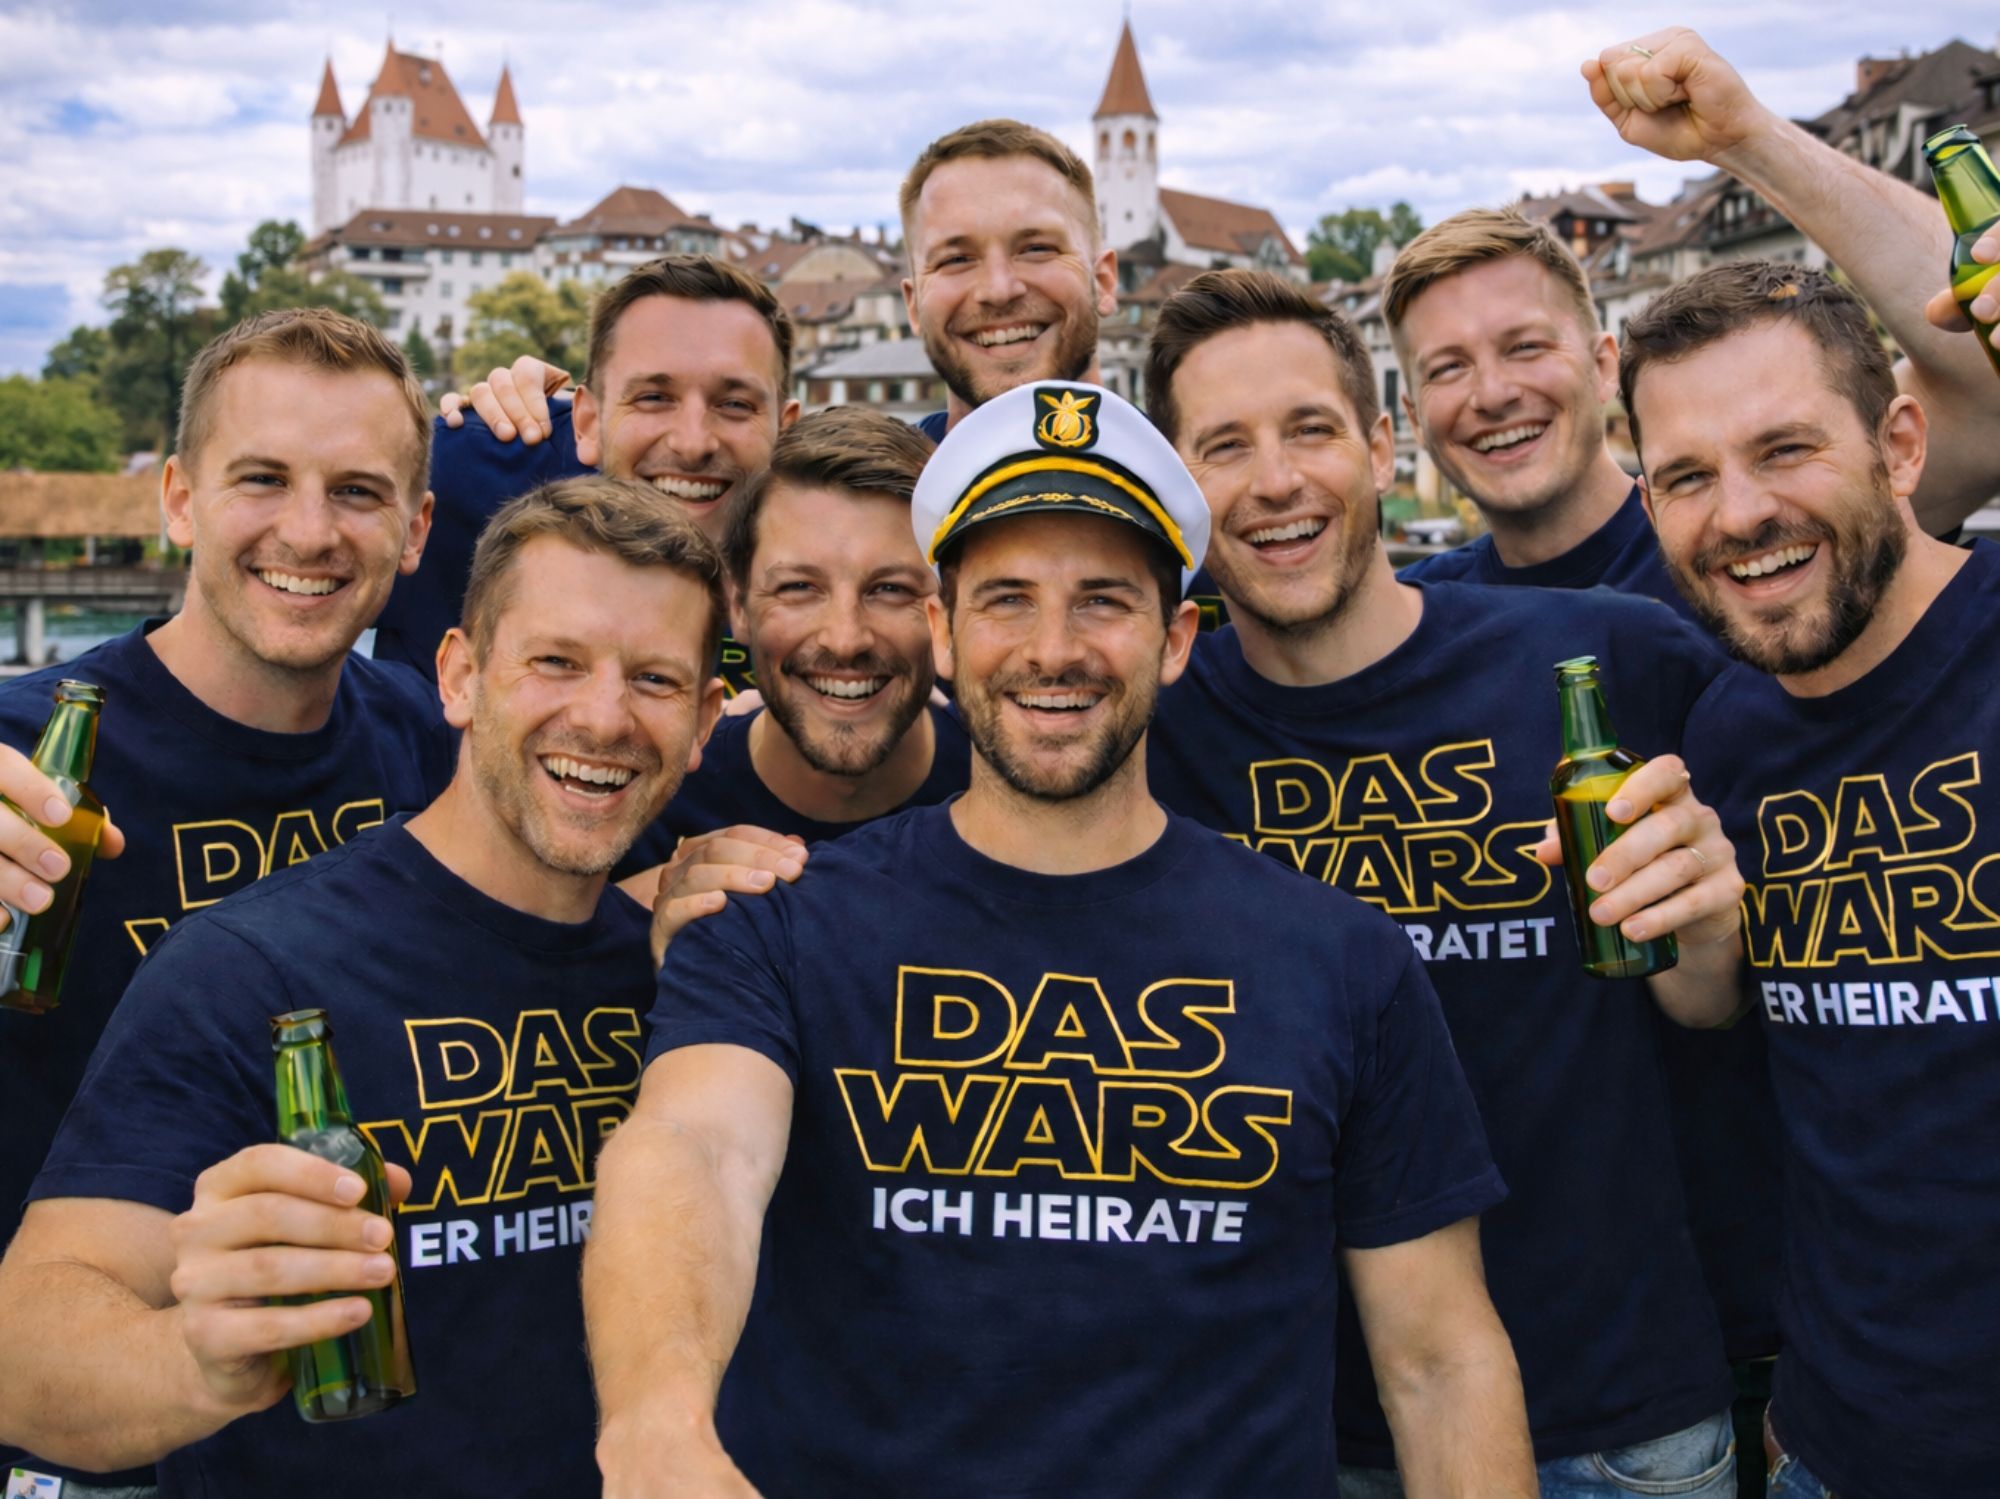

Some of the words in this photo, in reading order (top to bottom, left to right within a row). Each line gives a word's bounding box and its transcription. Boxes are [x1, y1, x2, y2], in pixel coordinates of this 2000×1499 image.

[1249, 739, 1495, 835] DAS
[1758, 751, 1981, 878] DAS
[1399, 916, 1555, 961] RATET
[895, 965, 1236, 1078] DAS
[1761, 979, 1808, 1025] ER
[404, 1007, 642, 1110] DAS
[834, 1068, 1293, 1190] WARS
[410, 1219, 480, 1268] ER
[873, 1187, 973, 1236] ICH
[993, 1192, 1249, 1242] HEIRATE
